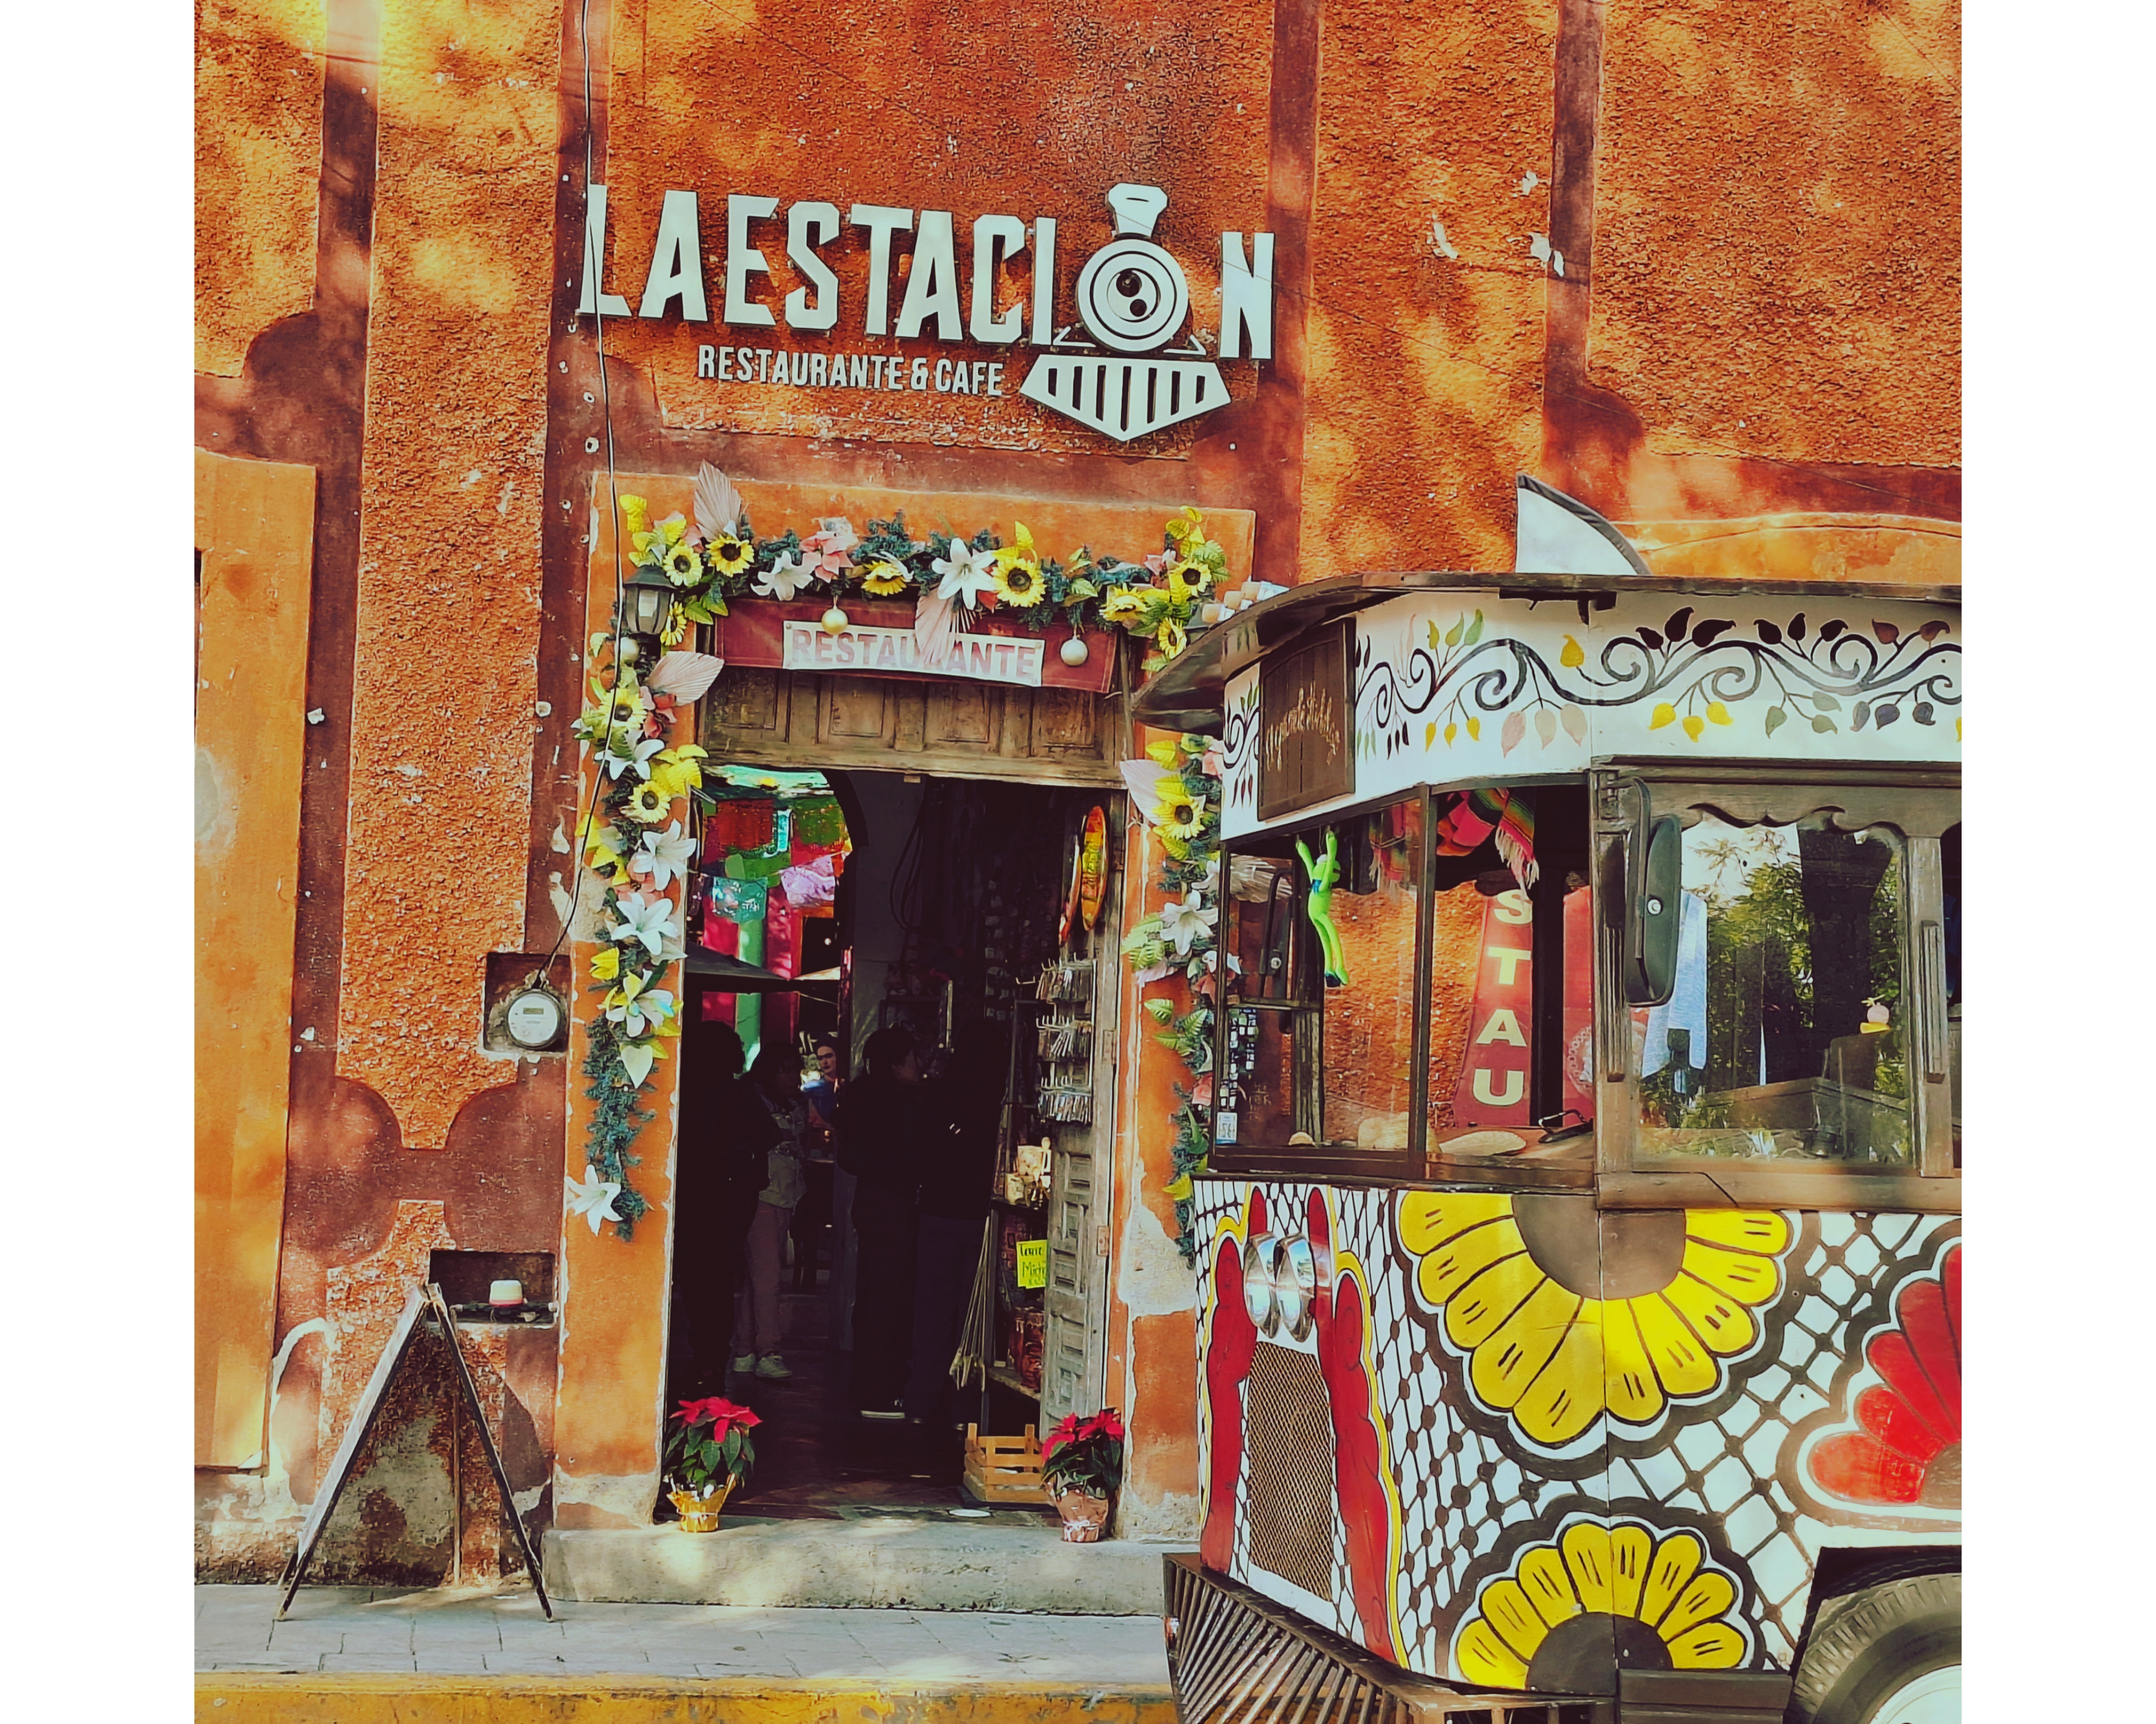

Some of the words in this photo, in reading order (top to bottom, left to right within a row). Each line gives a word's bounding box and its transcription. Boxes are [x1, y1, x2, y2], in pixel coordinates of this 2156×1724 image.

[698, 345, 904, 390] RESTAURANTE
[911, 357, 929, 390] &
[935, 359, 1003, 396] CAFE
[792, 629, 1036, 679] RESTAUANTE
